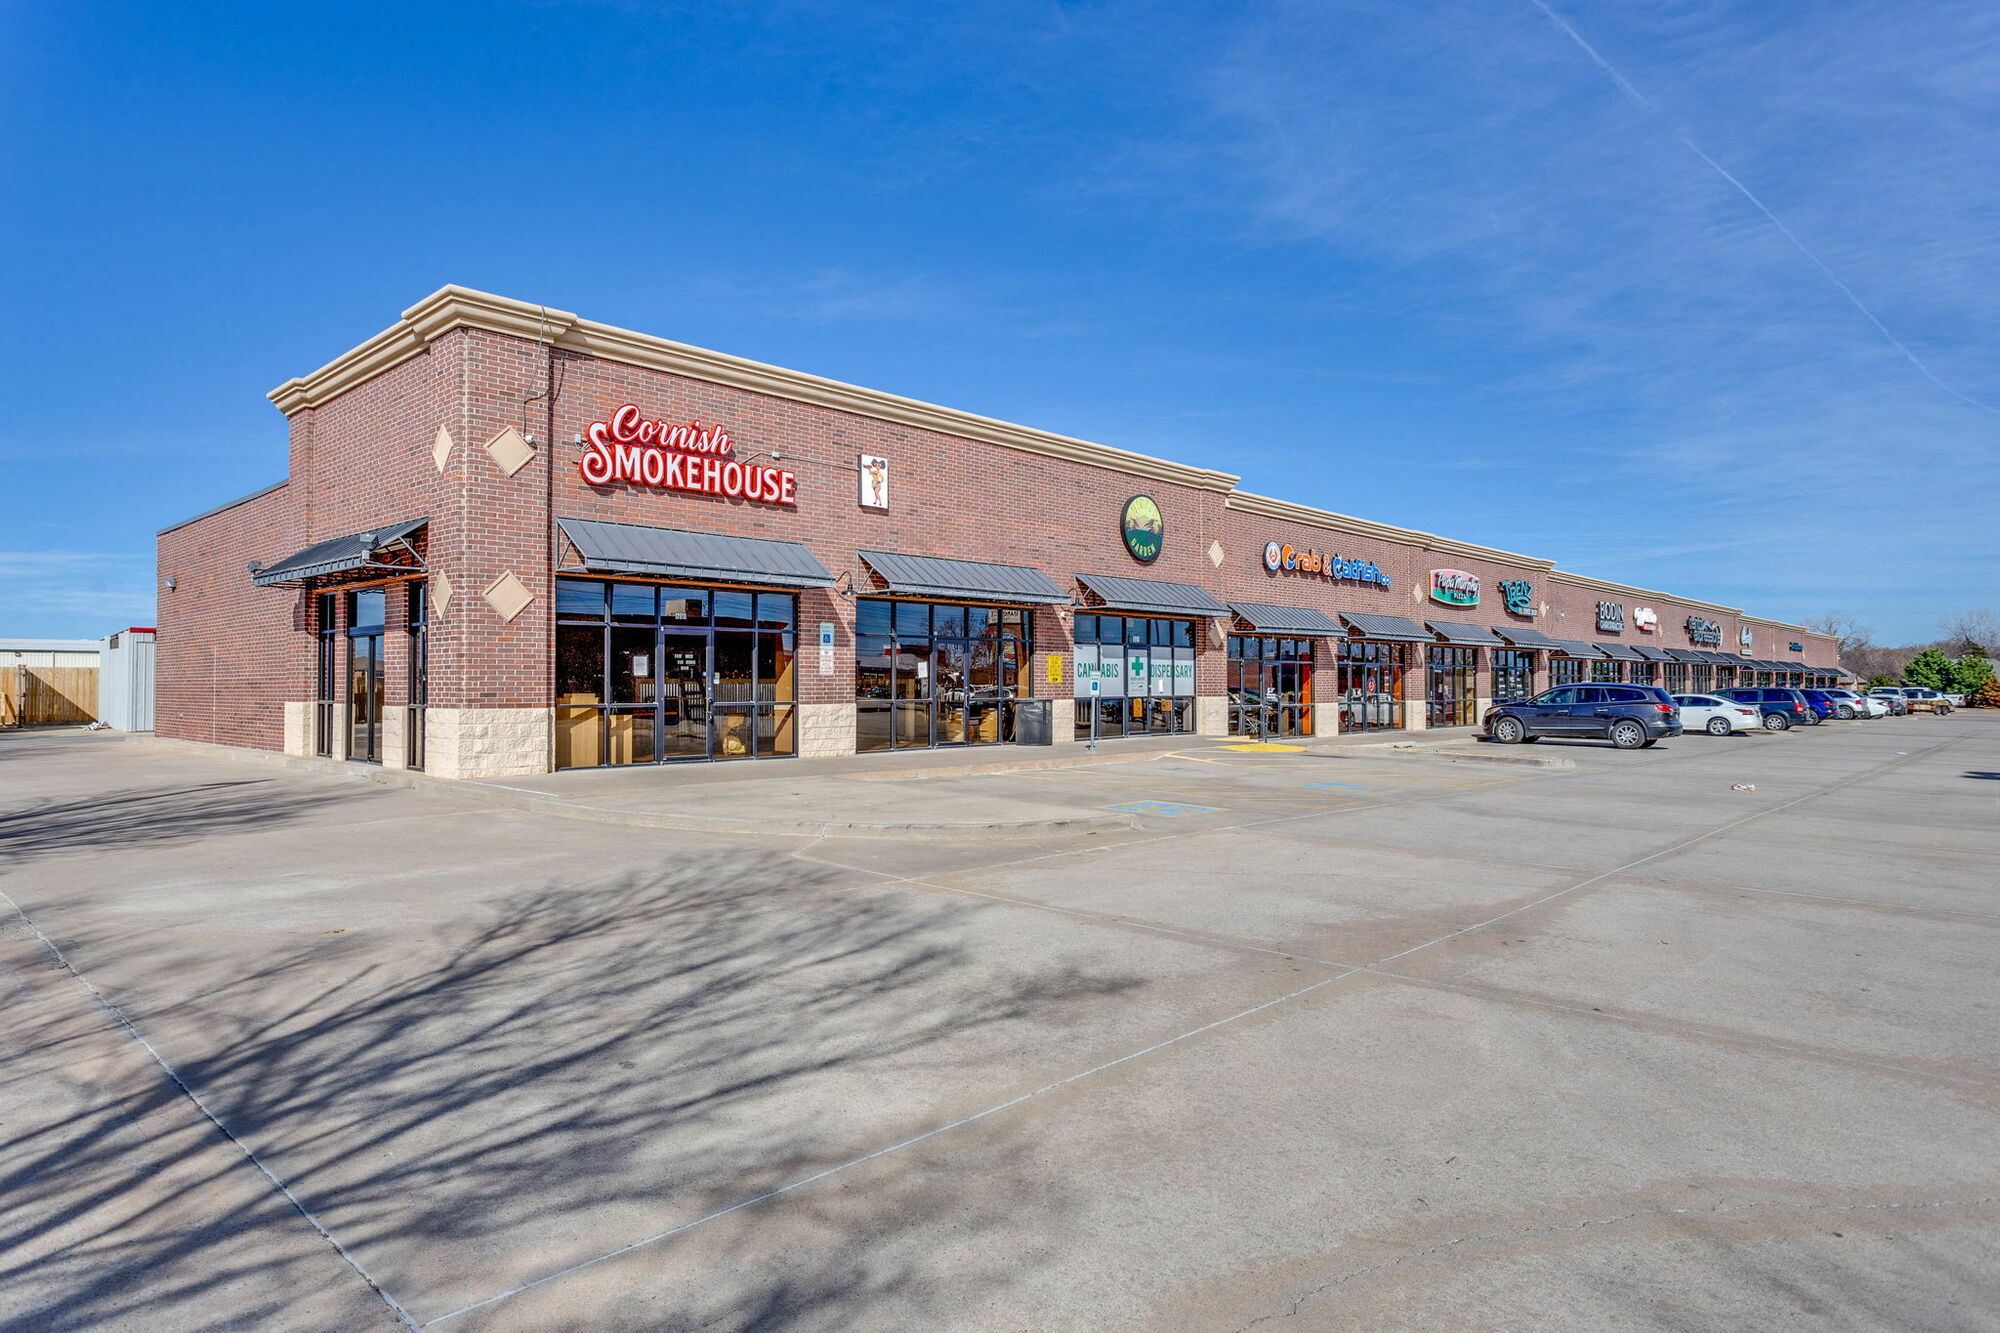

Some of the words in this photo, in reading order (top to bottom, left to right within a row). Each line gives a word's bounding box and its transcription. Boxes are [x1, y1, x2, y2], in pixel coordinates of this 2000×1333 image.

[611, 403, 732, 455] Cornish
[581, 420, 795, 503] SMOKEHOUSE
[1281, 543, 1322, 573] Crab
[1332, 553, 1381, 584] Catfish
[1077, 662, 1119, 678] CANABIS
[1148, 664, 1193, 678] DISPESARY
